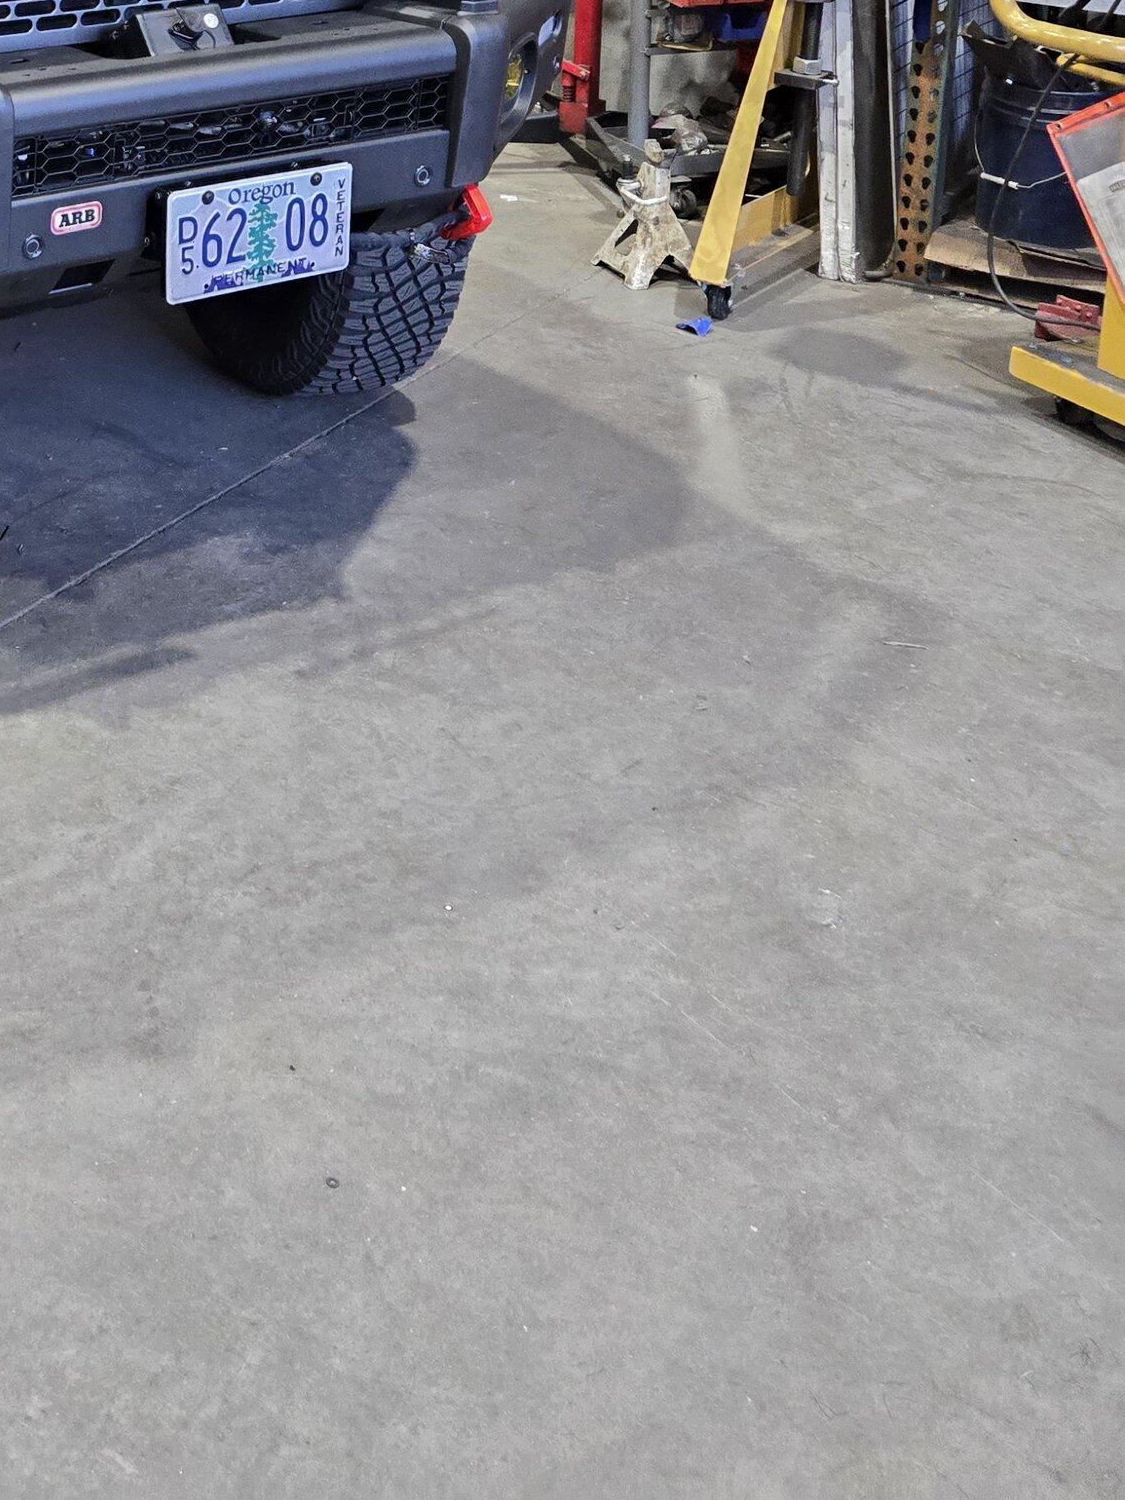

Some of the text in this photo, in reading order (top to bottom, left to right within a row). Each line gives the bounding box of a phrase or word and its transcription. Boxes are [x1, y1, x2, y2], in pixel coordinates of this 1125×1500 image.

[227, 181, 297, 206] Oregon
[58, 208, 96, 228] ARB
[334, 178, 347, 258] VETERAN
[211, 256, 308, 287] PERMANENT
